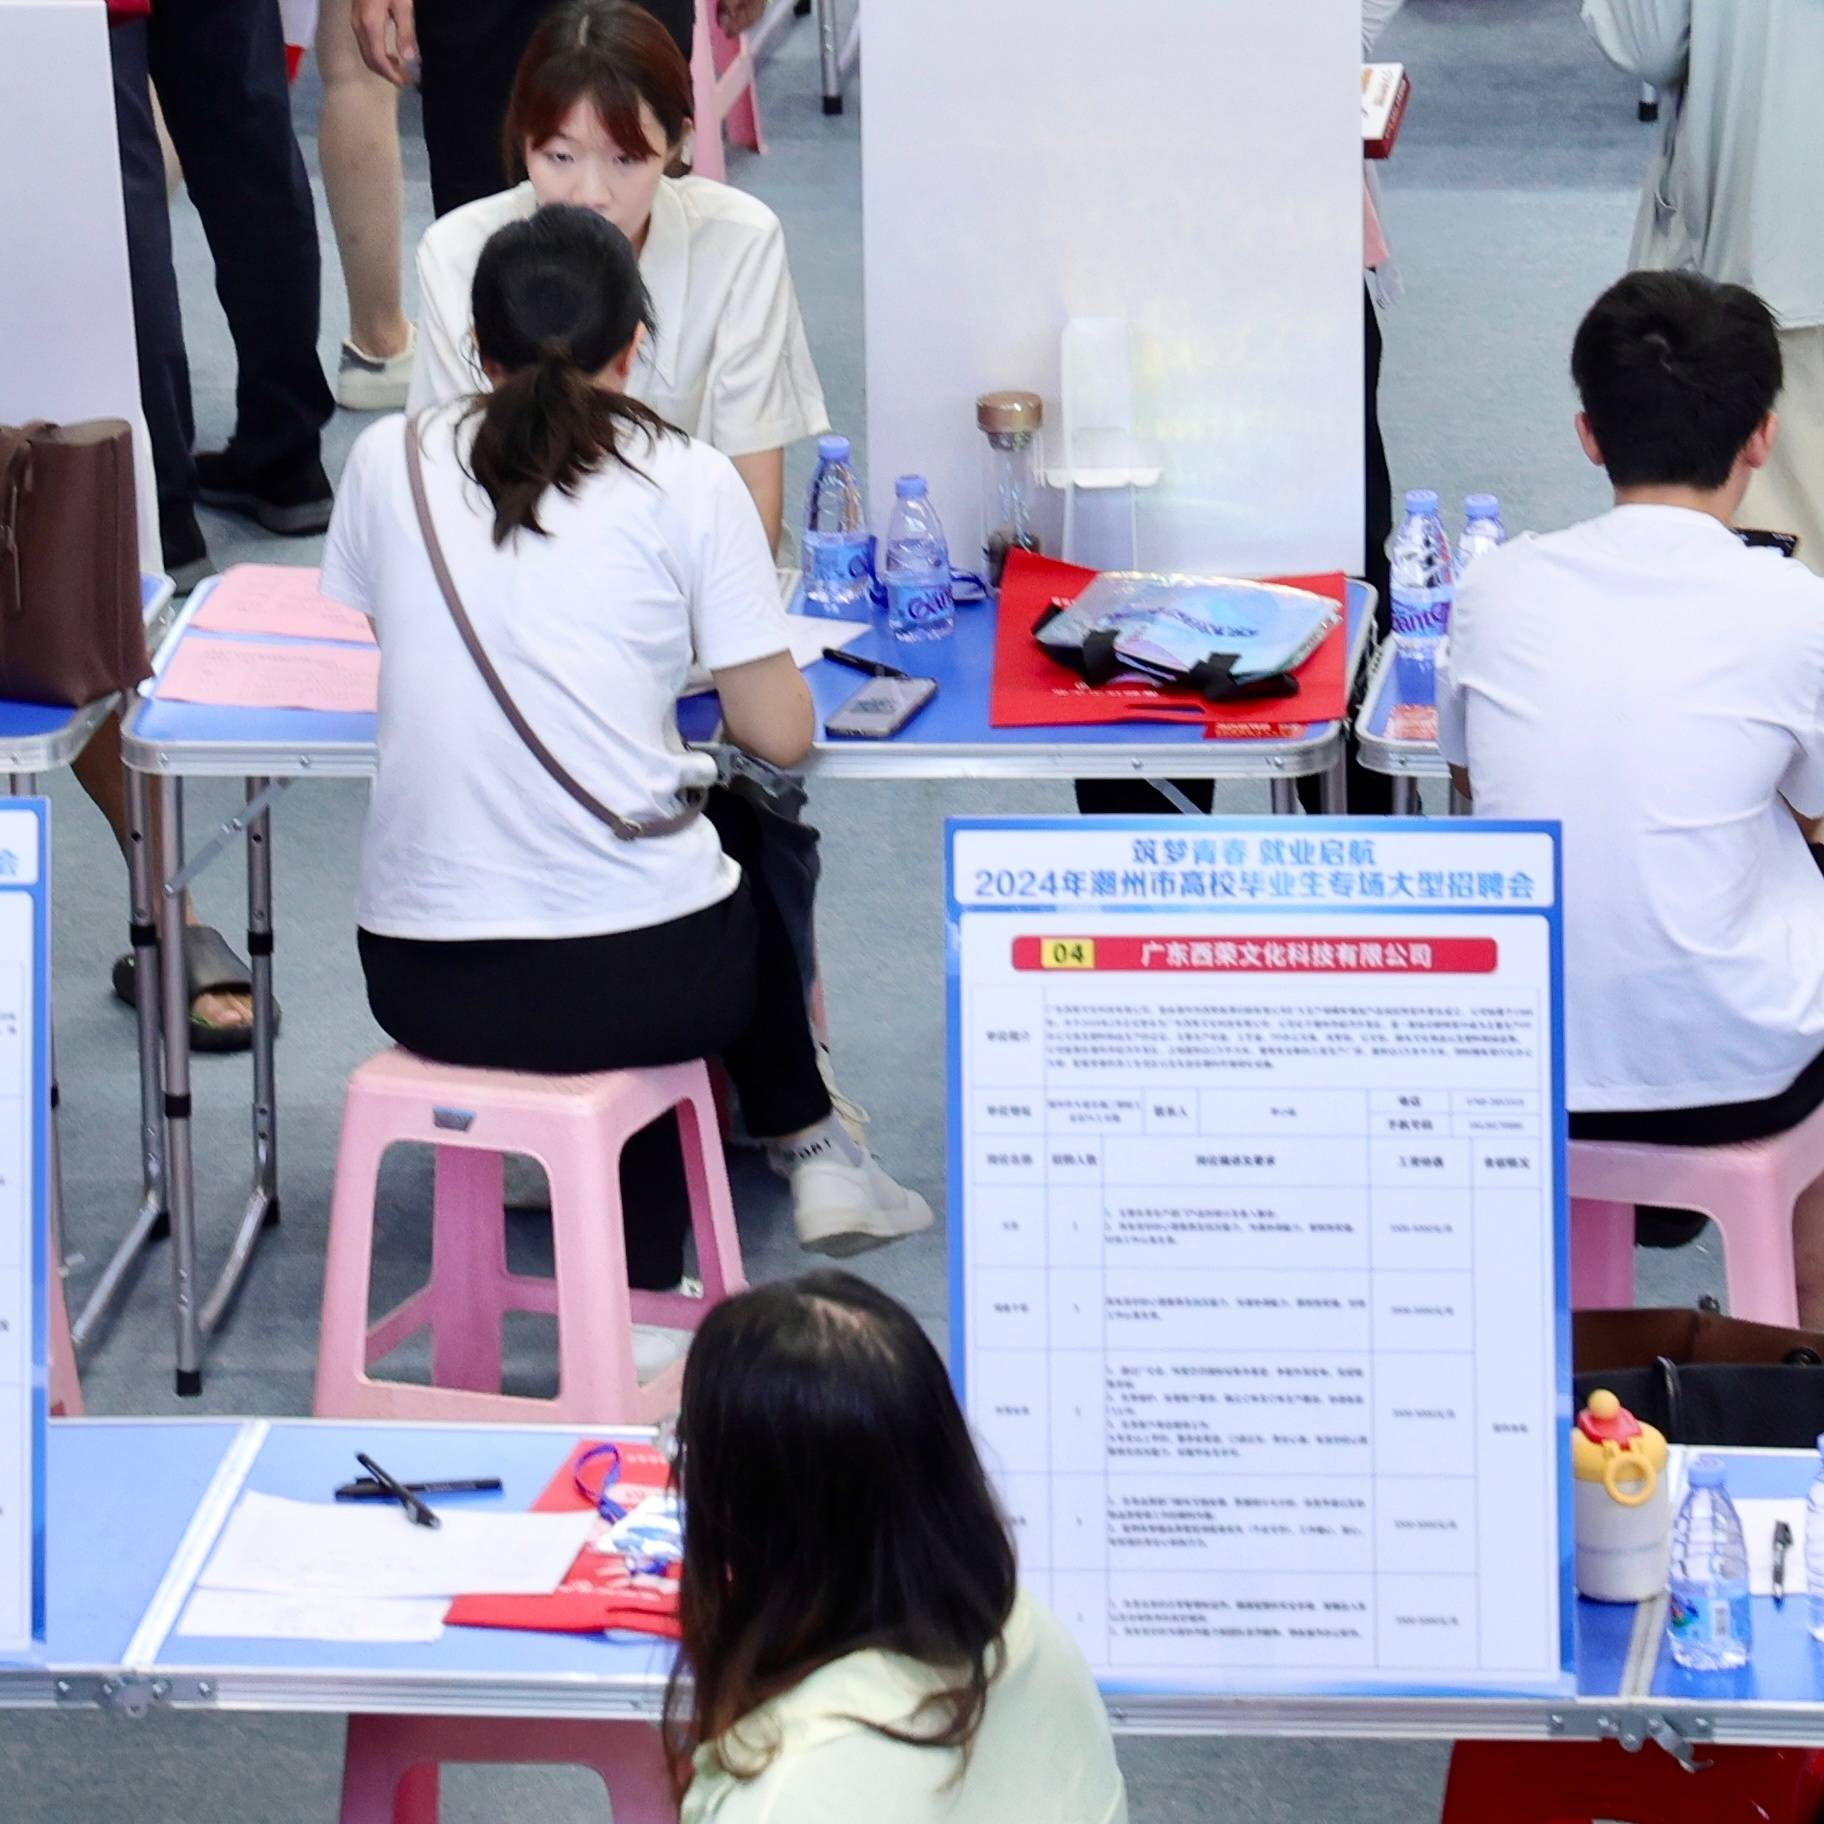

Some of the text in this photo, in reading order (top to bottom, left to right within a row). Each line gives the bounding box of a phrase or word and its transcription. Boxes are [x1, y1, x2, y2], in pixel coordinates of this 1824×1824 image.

[1132, 838, 1377, 867] 筑梦青春 就业启航
[973, 868, 1537, 901] 2024年潮州市高校毕业生专场大型招聘会
[1053, 943, 1086, 965] 04
